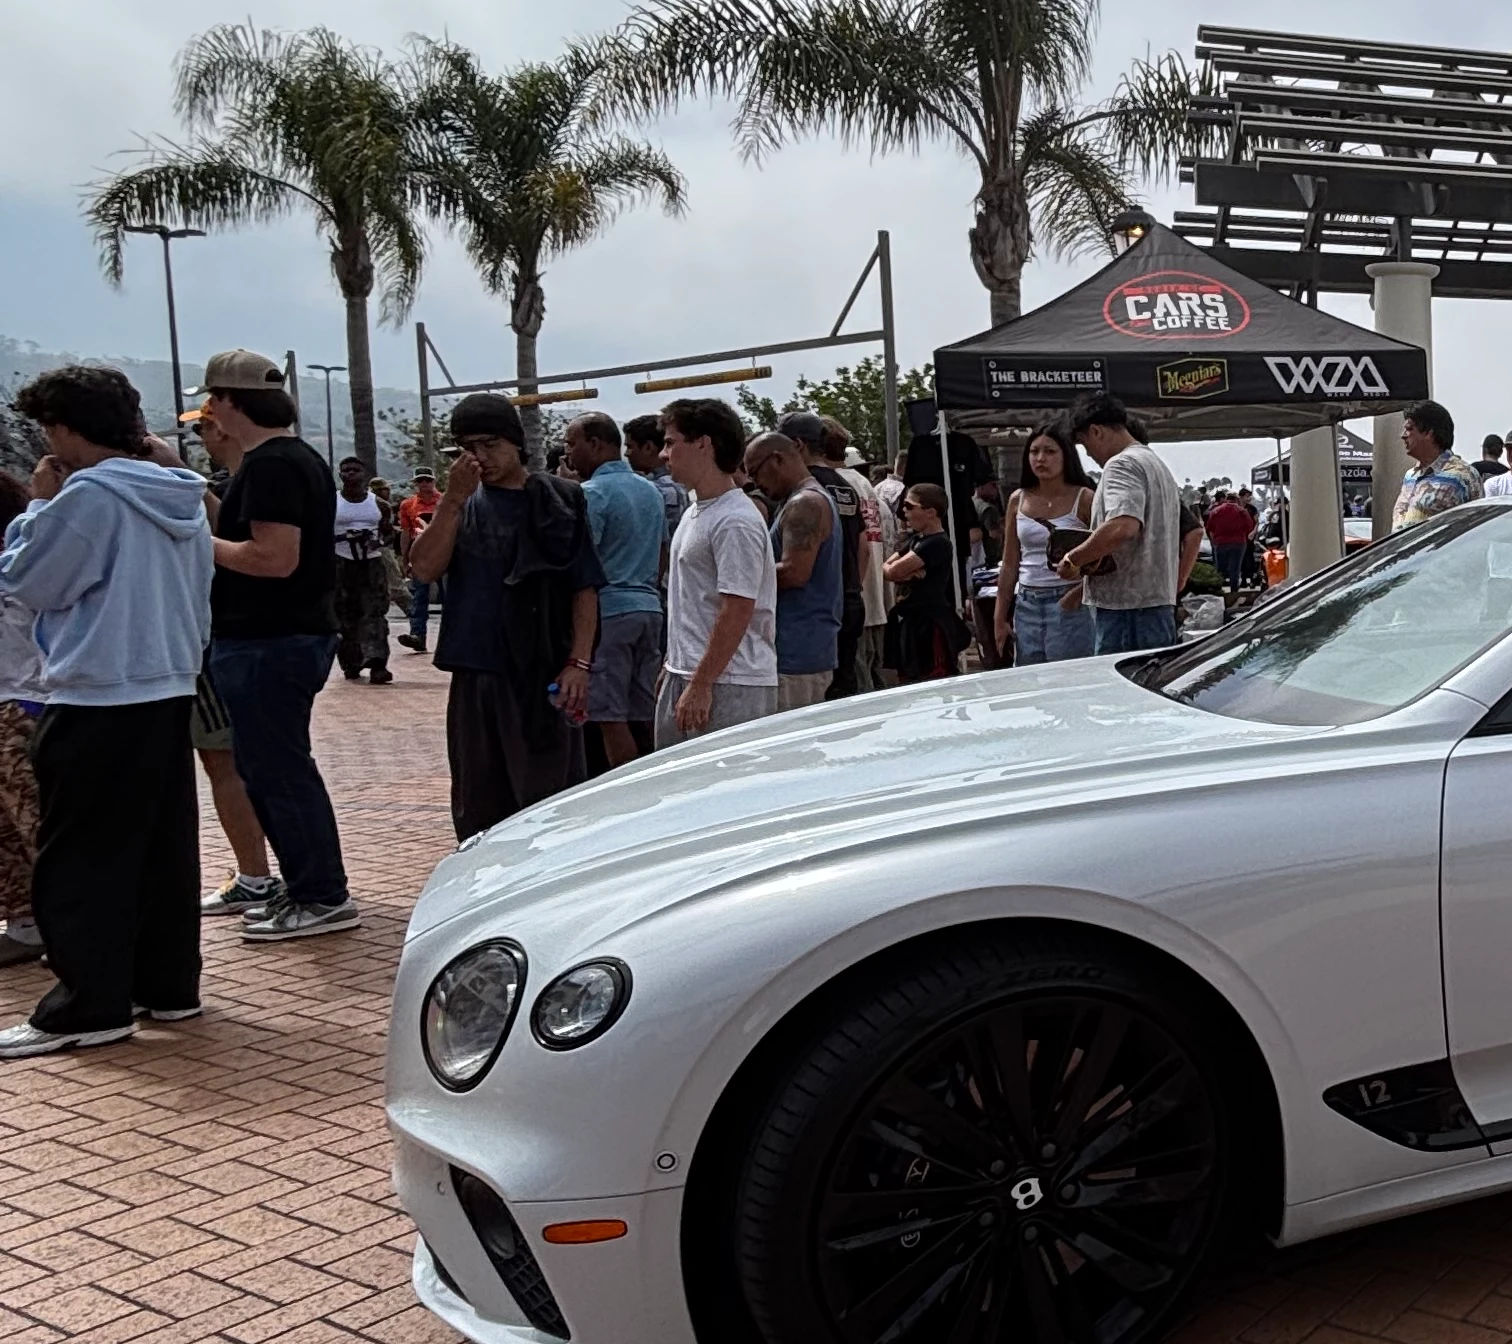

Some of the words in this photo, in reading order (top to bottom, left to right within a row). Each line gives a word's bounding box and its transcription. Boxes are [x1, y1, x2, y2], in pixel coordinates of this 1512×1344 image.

[1125, 292, 1228, 320] CARS
[1152, 315, 1232, 331] COFFEE
[990, 371, 1015, 382] THE
[1020, 371, 1102, 382] BRACKETEER
[1358, 1080, 1392, 1107] 12
